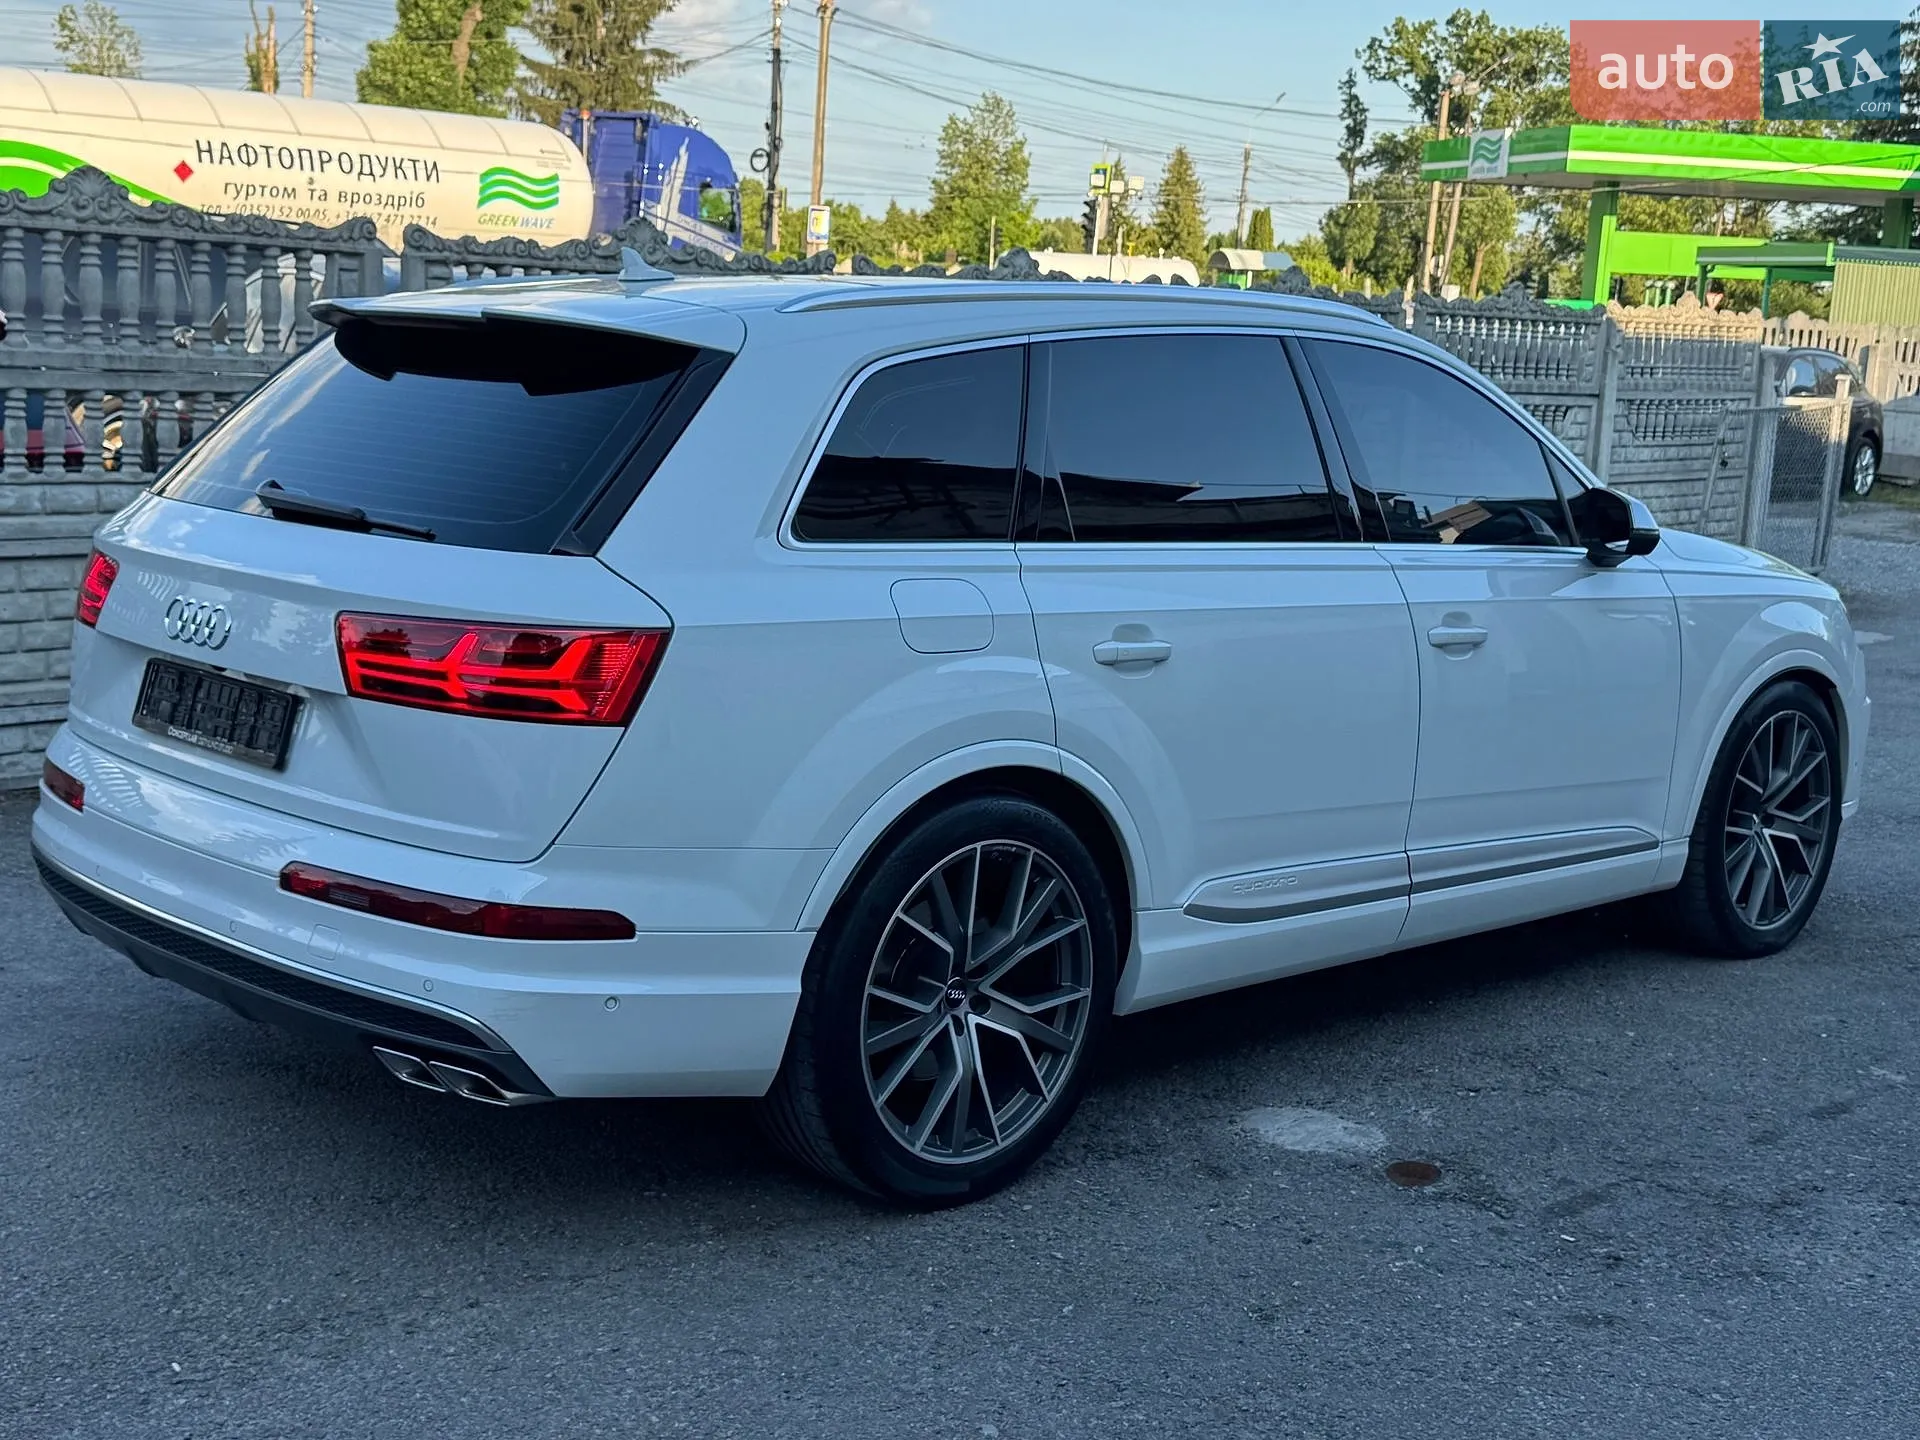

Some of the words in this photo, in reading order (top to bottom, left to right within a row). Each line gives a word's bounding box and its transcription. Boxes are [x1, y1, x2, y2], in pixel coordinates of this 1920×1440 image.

[195, 139, 440, 184] НАФТОПРОДУКТИ
[223, 182, 297, 201] гуртом
[307, 187, 328, 202] та
[337, 189, 426, 212] вроздріб
[477, 212, 519, 227] GREEN
[519, 216, 555, 229] WAVE
